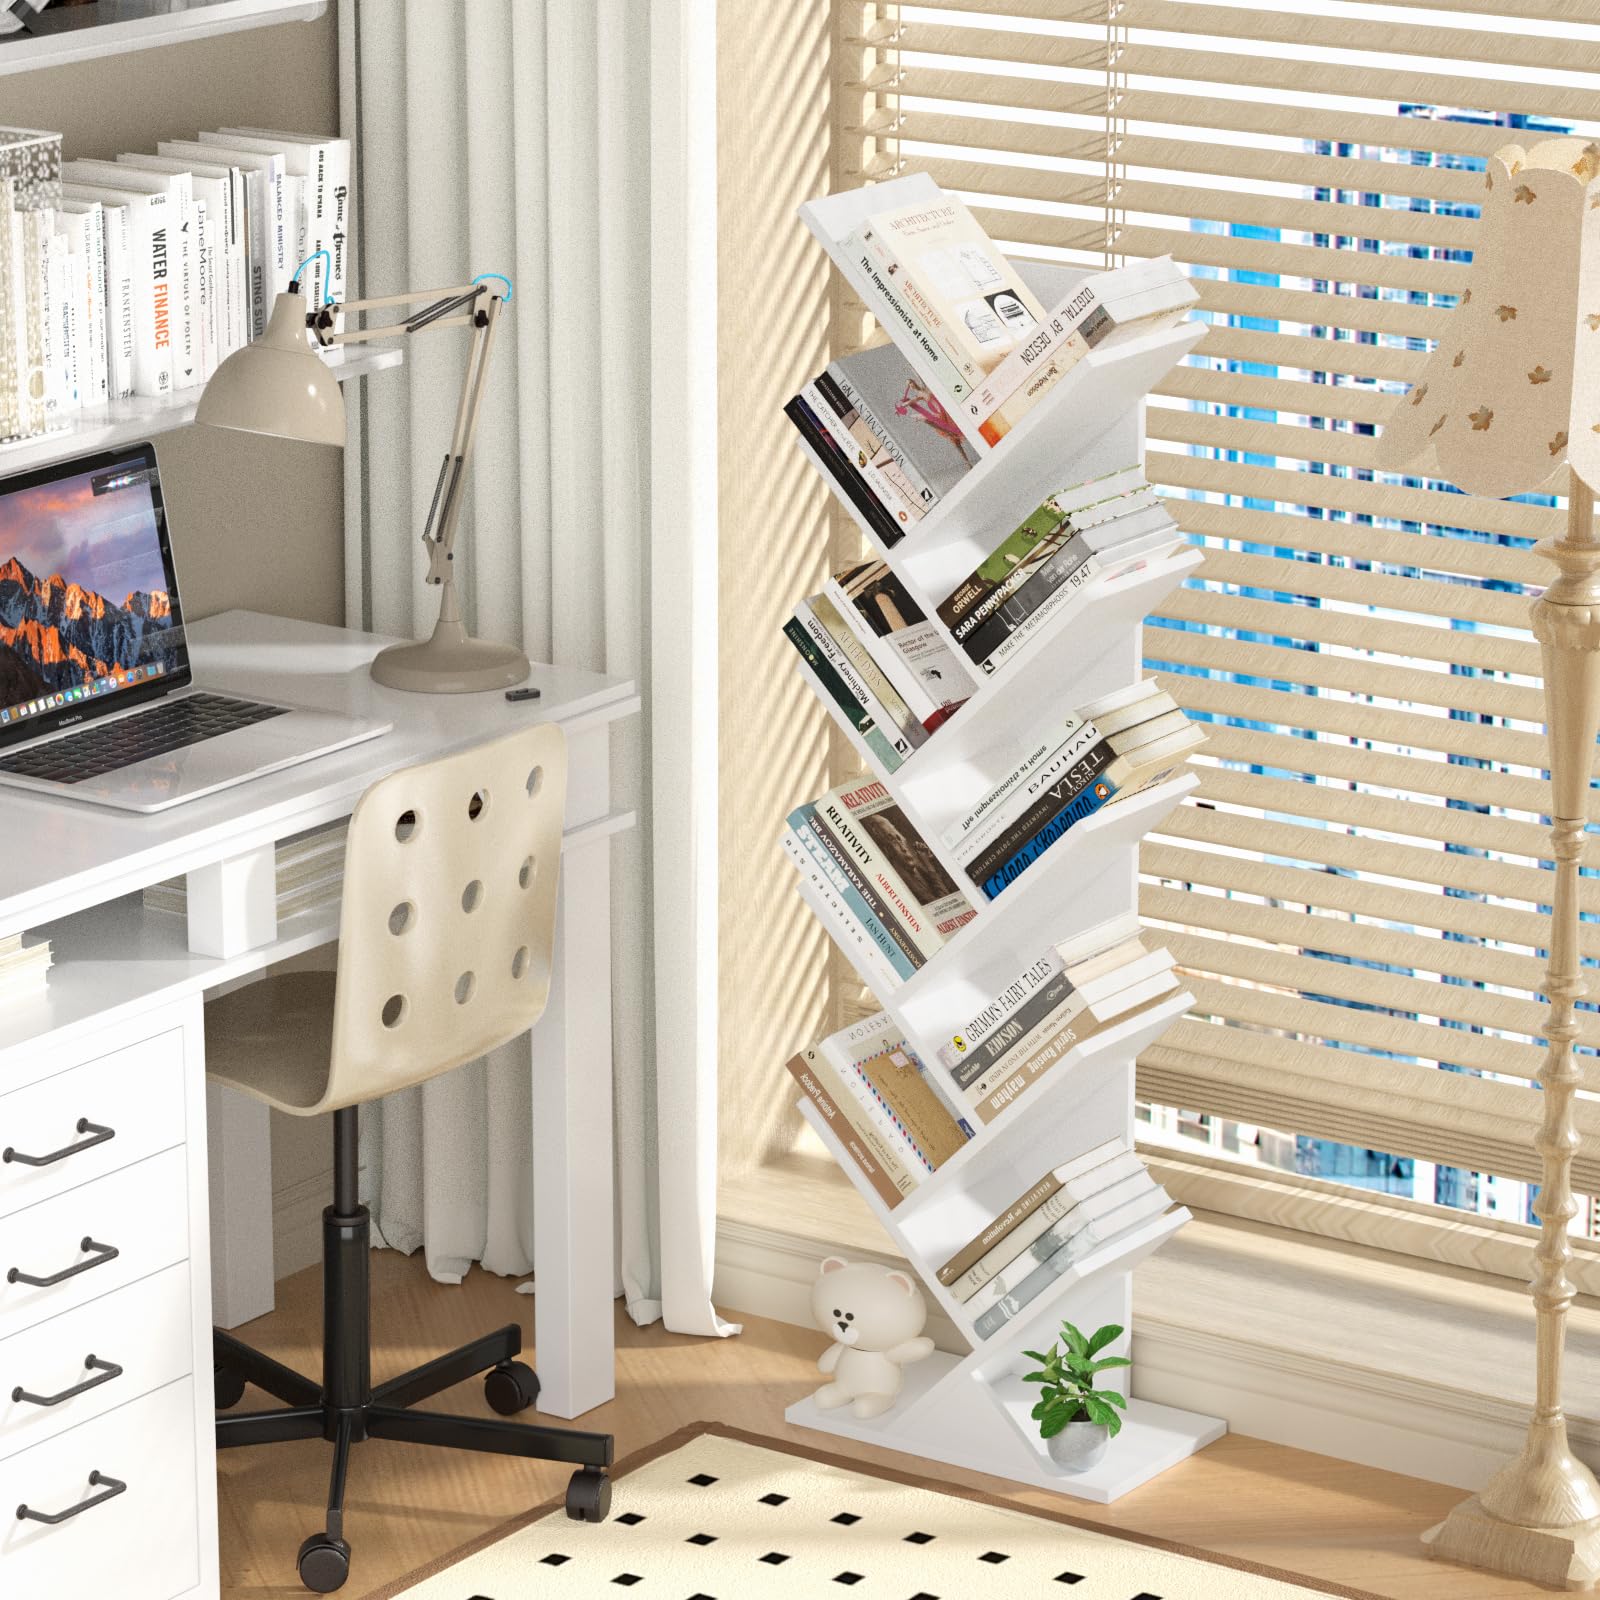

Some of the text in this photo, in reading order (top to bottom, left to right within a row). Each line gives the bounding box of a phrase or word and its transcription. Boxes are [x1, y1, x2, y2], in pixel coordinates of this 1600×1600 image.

[152, 228, 170, 350] WATER FINANCE
[253, 266, 262, 301] STING
[121, 278, 131, 358] FRANKENSTEIN
[860, 256, 939, 362] The Impressionists at Home
[1020, 287, 1096, 366] DIGITAL BY DESIGN
[952, 585, 982, 614] ORWELL
[954, 582, 972, 602] GEORGE
[955, 616, 978, 639] SARA
[975, 568, 1026, 622] PENNYPACKER
[998, 641, 1015, 657] MAKE
[1012, 632, 1025, 644] THE
[1070, 564, 1092, 588] 19,47
[807, 620, 836, 660] Freedom
[838, 661, 870, 705] Machinery
[860, 660, 882, 688] DAYS
[840, 781, 890, 810] RELATIVITY
[1048, 750, 1104, 800] TESLA
[1067, 768, 1096, 796] NIKOLA
[796, 824, 851, 894] STEAM
[819, 833, 867, 893] KARAMAZOV
[826, 806, 873, 865] RELATIVITY
[876, 872, 898, 902] ALBERT
[896, 898, 922, 932] EINSTEIN
[861, 890, 876, 910] THE
[865, 917, 897, 958] IAN HUNT
[889, 926, 922, 968] DOSTOEVSKY
[936, 916, 958, 934] ALBERT
[965, 957, 1053, 1043] GRIMM'S FAIRY TALES
[984, 1019, 1024, 1058] EDISON
[990, 1028, 1078, 1110] Sigrid Rausing mayhem
